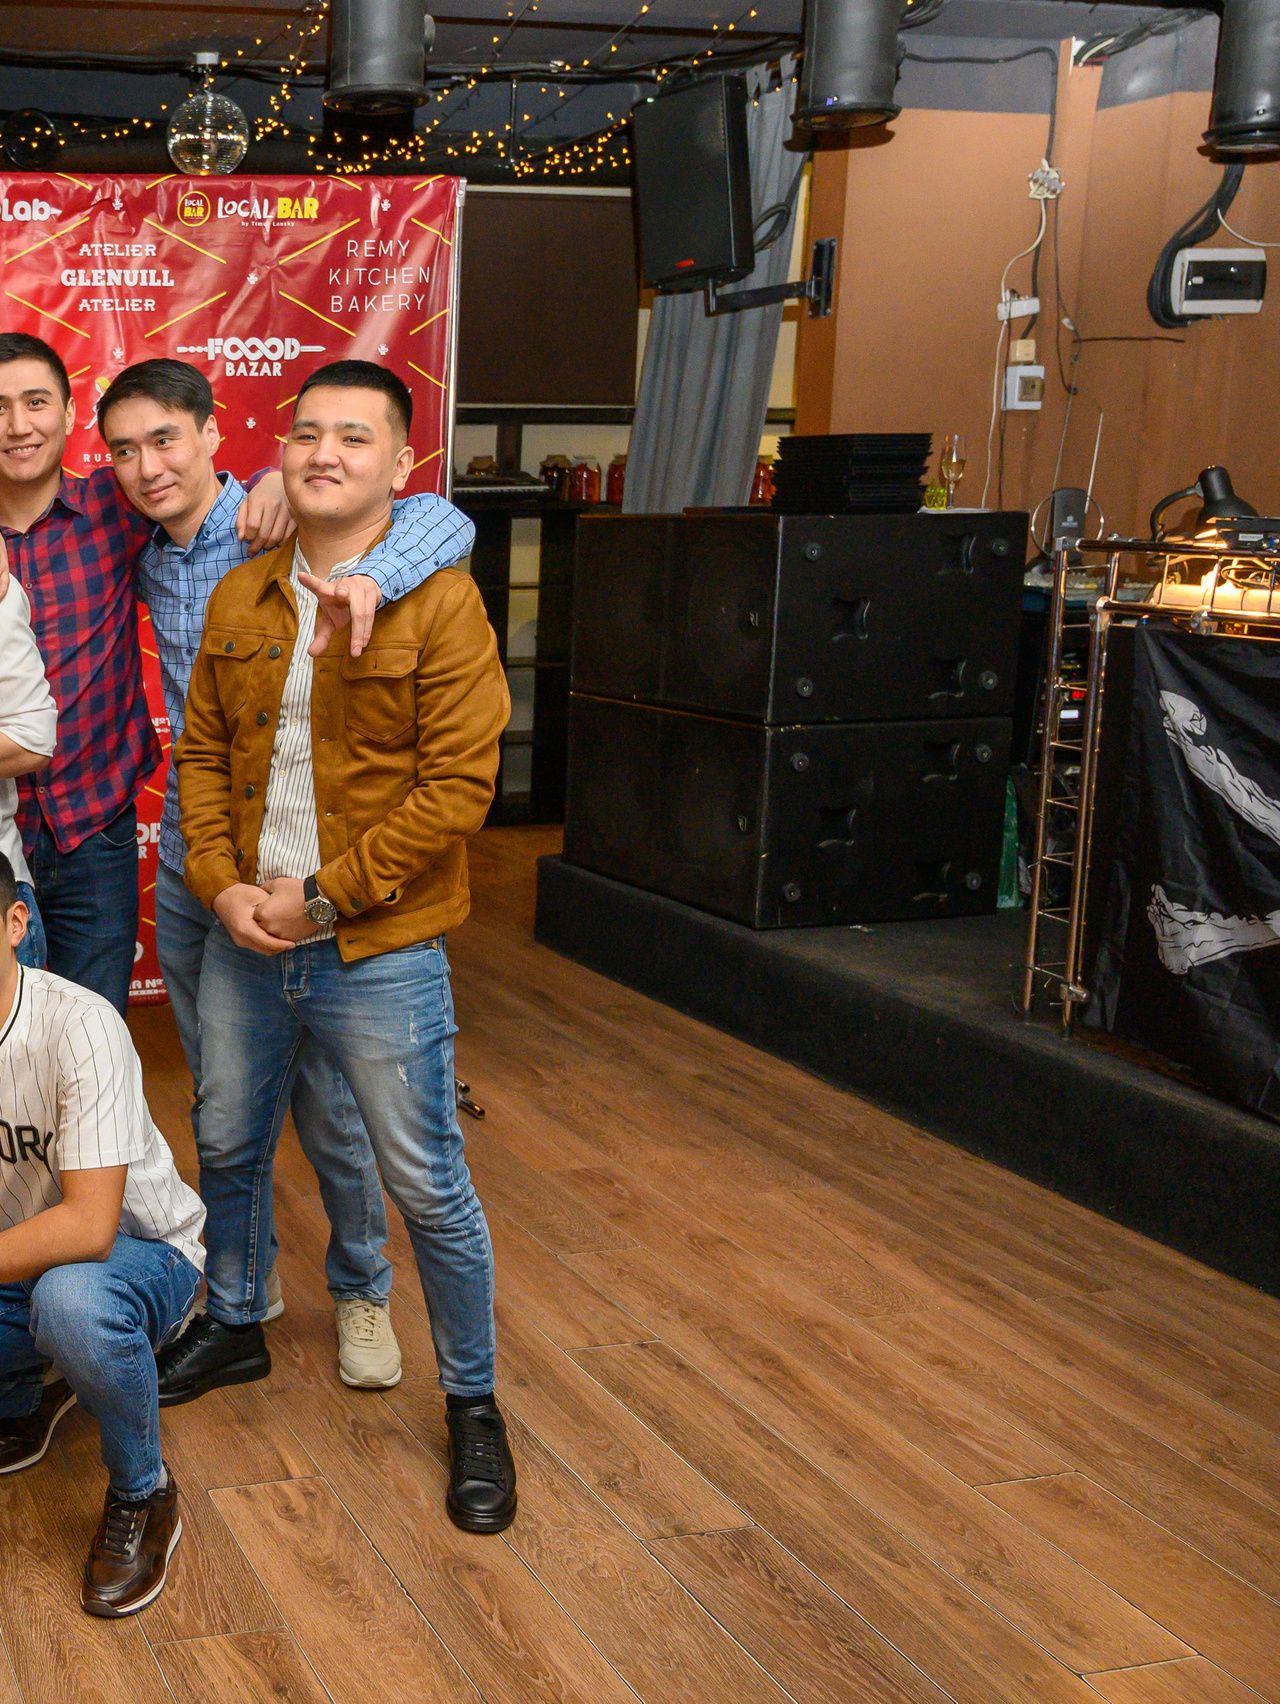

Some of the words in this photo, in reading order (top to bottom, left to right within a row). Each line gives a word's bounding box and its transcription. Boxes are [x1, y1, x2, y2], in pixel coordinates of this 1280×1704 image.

[183, 206, 205, 217] BAR
[277, 197, 320, 219] BAR
[78, 243, 157, 257] ATELIER
[346, 239, 411, 258] REMY
[60, 269, 175, 287] GLENUILL
[328, 266, 430, 286] KITCHEN
[78, 298, 156, 312] ATELIER
[330, 293, 426, 313] BAKERY
[225, 361, 283, 377] BAZAR
